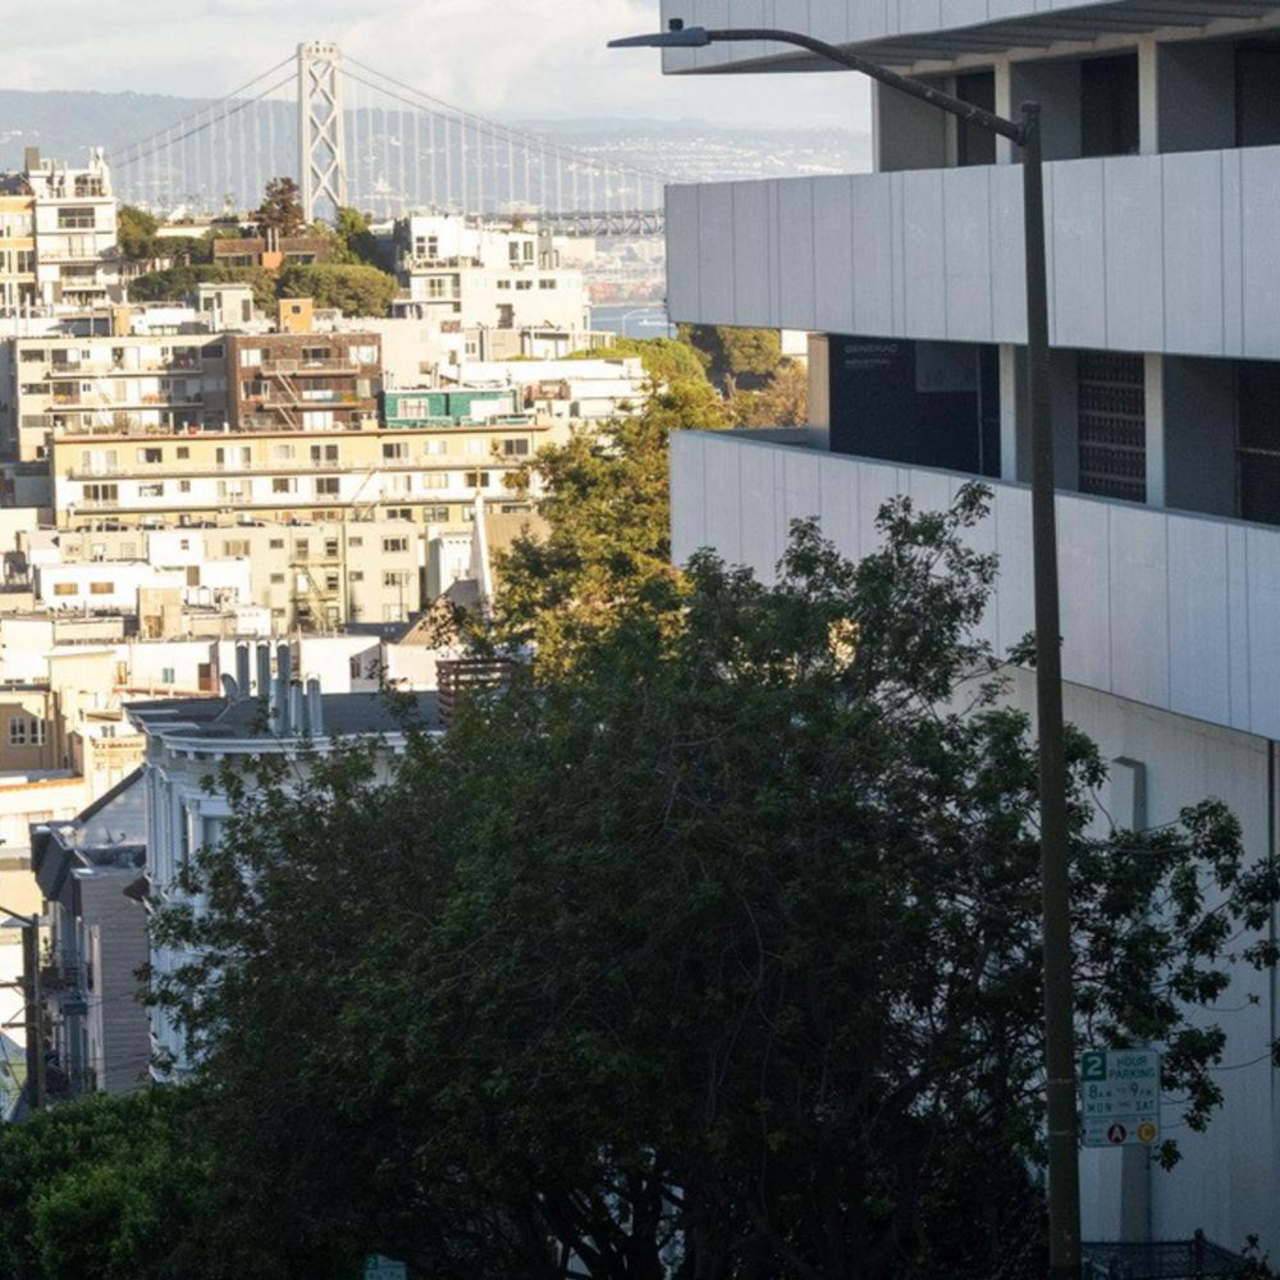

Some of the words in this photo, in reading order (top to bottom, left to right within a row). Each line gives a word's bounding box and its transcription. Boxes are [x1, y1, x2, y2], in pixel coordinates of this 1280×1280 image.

[1086, 1056, 1102, 1076] 2
[1116, 1055, 1147, 1067] HOUR
[1109, 1067, 1155, 1080] PARKING
